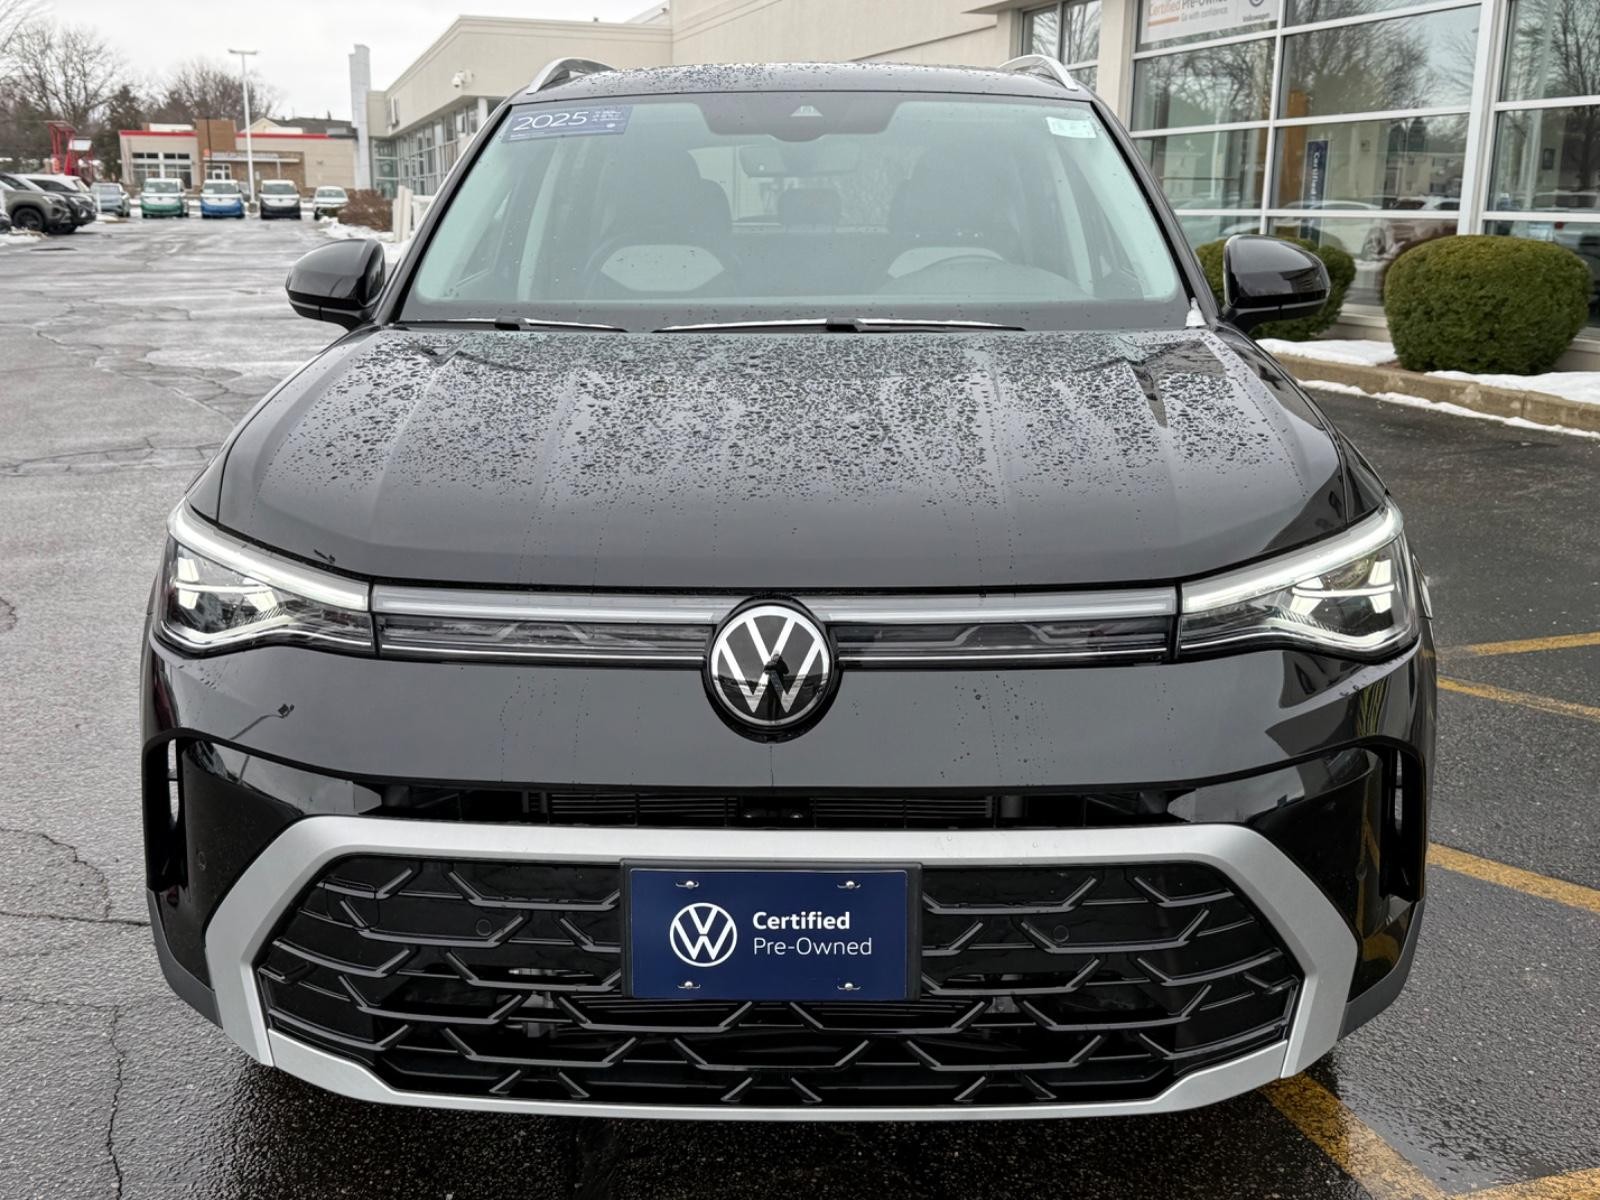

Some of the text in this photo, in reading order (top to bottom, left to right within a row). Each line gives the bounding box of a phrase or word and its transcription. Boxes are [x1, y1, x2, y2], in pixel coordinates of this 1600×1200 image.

[513, 111, 589, 131] 2025
[752, 911, 850, 930] Certified
[753, 937, 872, 955] Pre-Owned
